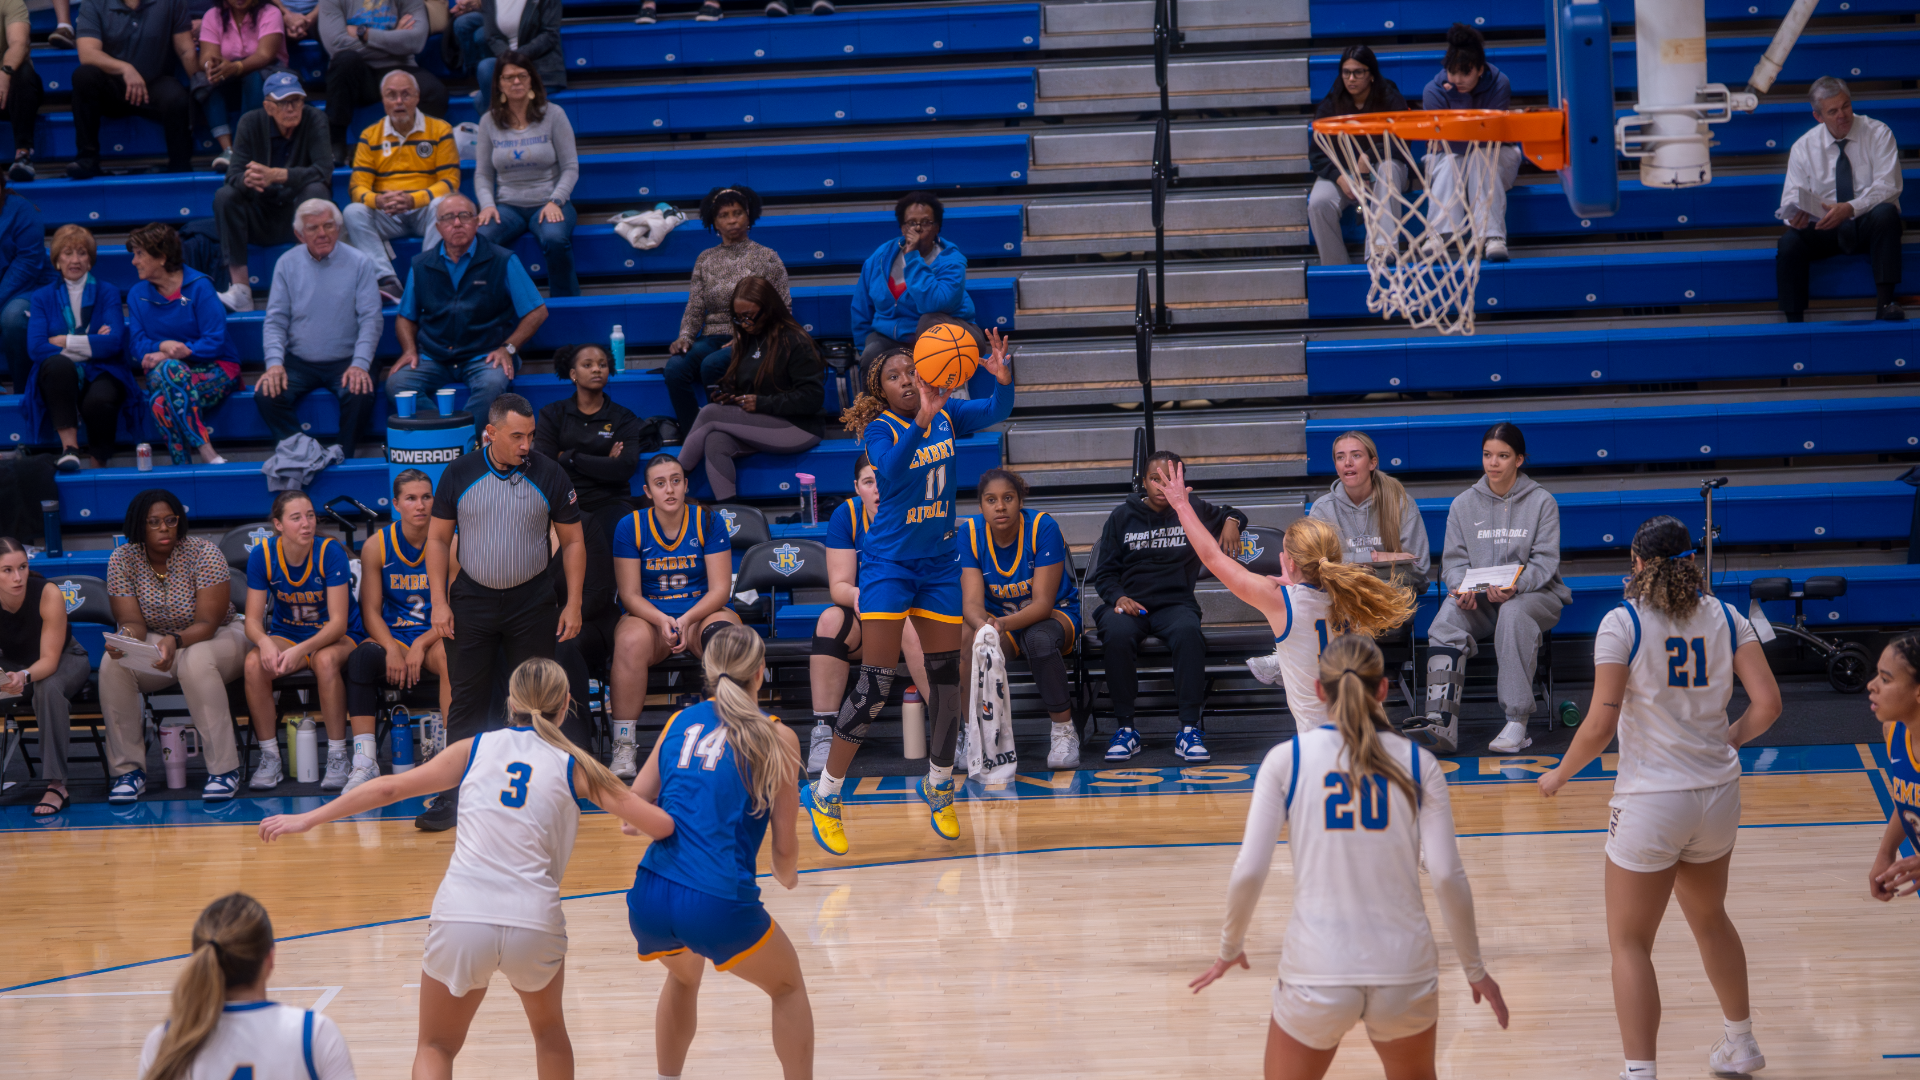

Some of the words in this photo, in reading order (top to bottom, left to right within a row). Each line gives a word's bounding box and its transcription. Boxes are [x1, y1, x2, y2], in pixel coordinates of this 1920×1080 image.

[390, 448, 461, 463] POWERADE
[909, 438, 955, 469] EMBRY
[925, 464, 947, 500] 11
[1123, 526, 1186, 543] EMBRY-RIDDL
[390, 574, 430, 590] EMBR
[657, 573, 689, 592] 10
[277, 589, 324, 604] EMBRY
[406, 594, 426, 621] 2
[290, 605, 321, 622] 15
[1665, 636, 1710, 688] 21
[677, 723, 728, 771] 14
[499, 761, 534, 809] 3
[1323, 770, 1390, 831] 20
